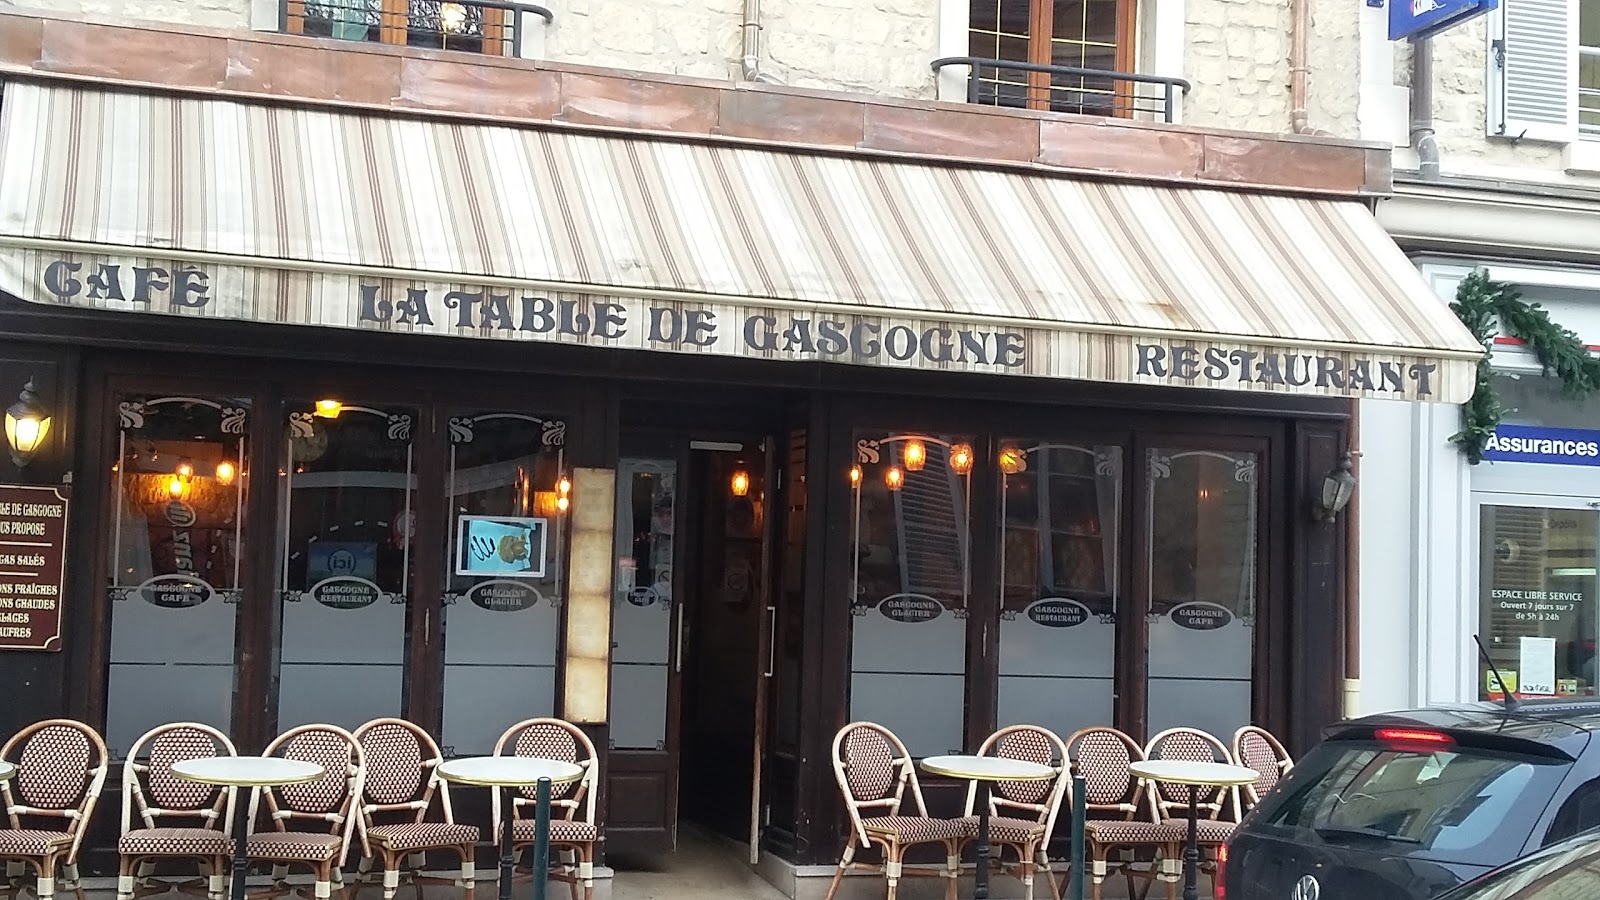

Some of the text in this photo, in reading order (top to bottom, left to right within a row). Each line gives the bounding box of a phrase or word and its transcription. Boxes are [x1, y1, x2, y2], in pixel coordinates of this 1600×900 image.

[43, 259, 1437, 396] CAFÉ LA TABLE DE GASCOGNE RESTAURANT
[1485, 432, 1599, 456] Assurances
[11, 503, 22, 516] DE
[23, 504, 62, 518] GASCOGNE
[11, 521, 46, 536] PROPOSE
[17, 553, 46, 567] SALÉS
[14, 583, 58, 596] FRAÎCHES
[322, 586, 370, 594] GASCOGNE
[480, 588, 527, 597] GASCOGNE
[320, 594, 373, 603] RESTAURANT
[1491, 589, 1583, 601] ESPACE LIBRE SERVICE
[15, 598, 56, 610] CHAUDES
[484, 597, 522, 606] GLACIER
[887, 600, 935, 609] GASCOGNE
[1500, 601, 1526, 610] Ouvert
[1528, 602, 1533, 610] 7
[1534, 602, 1554, 611] jours
[1569, 603, 1575, 611] 7
[891, 609, 931, 618] GLACIER
[1034, 606, 1080, 614] GASCOGNE
[1179, 609, 1224, 618] GASCOGNE
[1035, 614, 1081, 623] RESTAURANT
[1515, 612, 1525, 620] de
[1527, 612, 1537, 620] 5h
[1545, 613, 1560, 621] 24h
